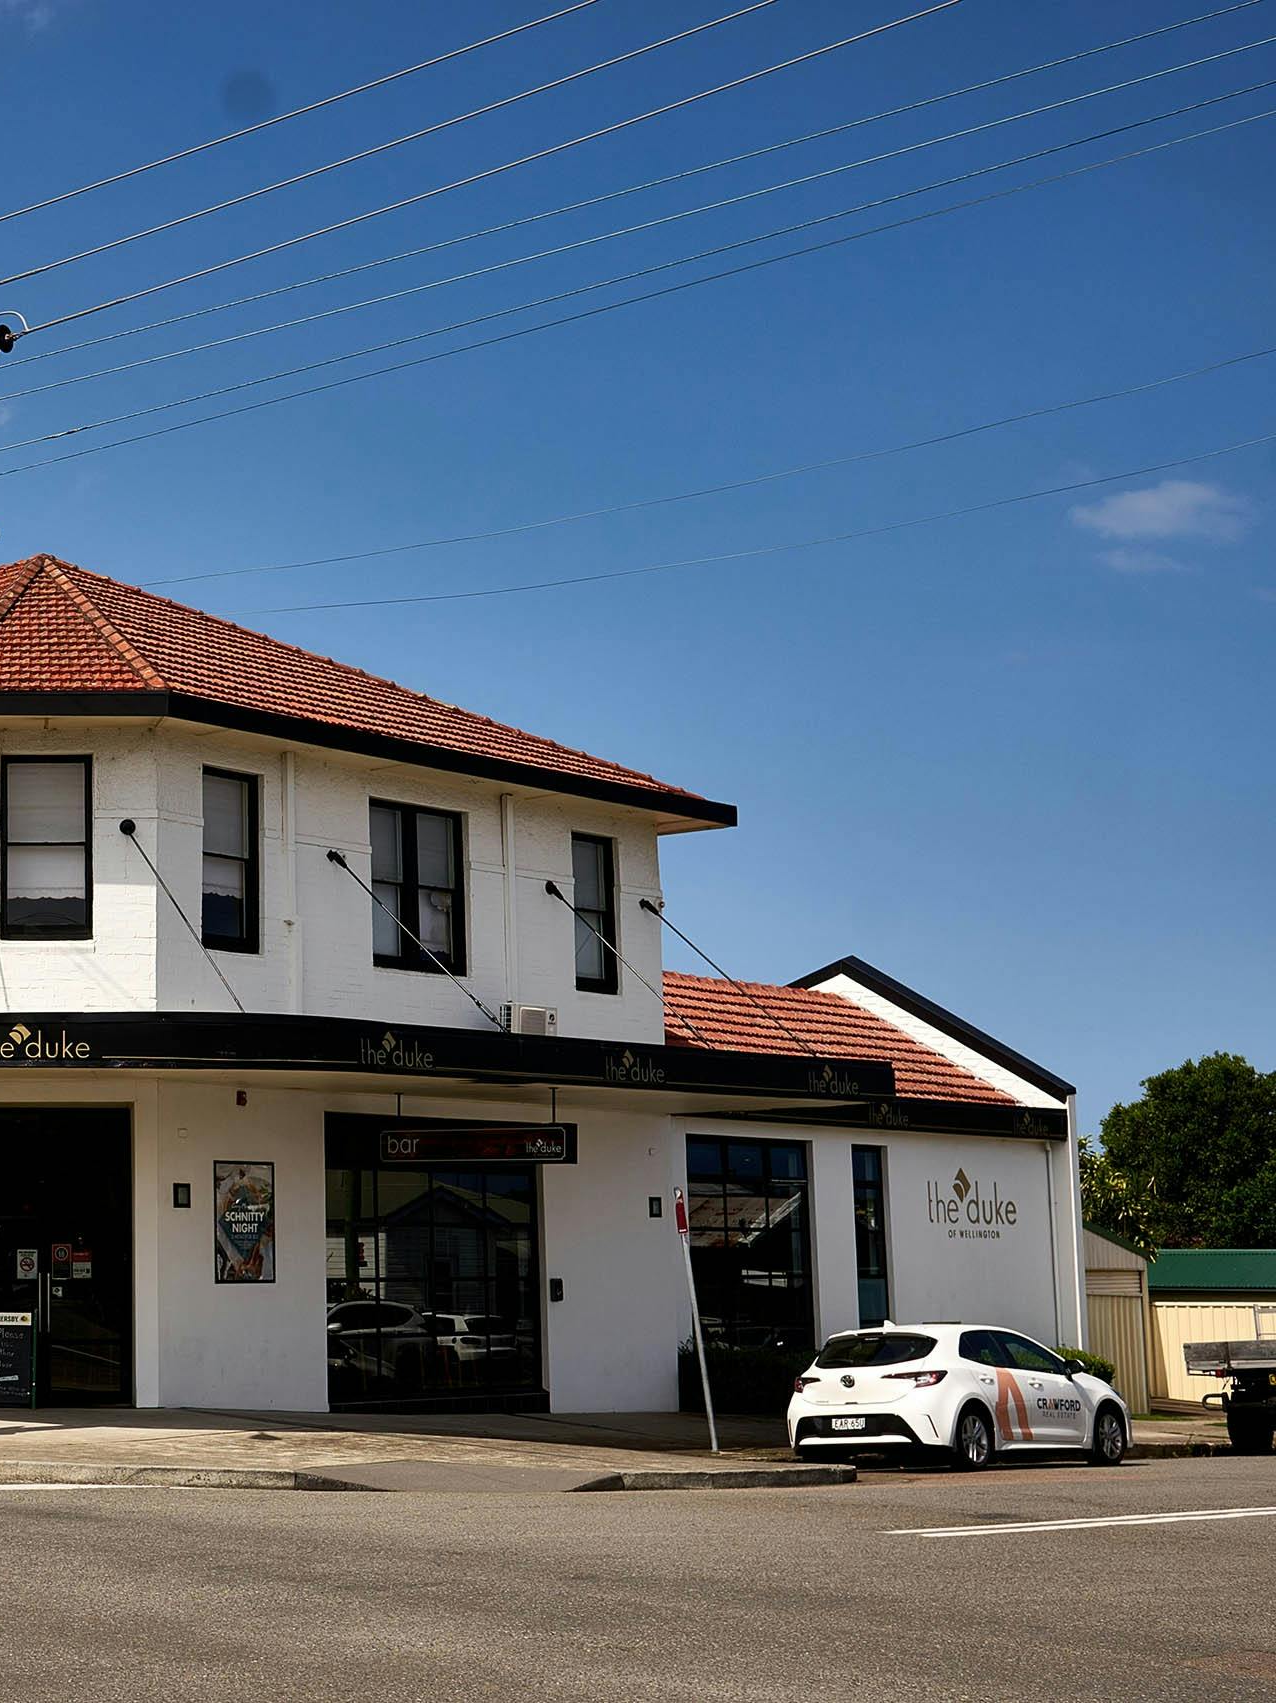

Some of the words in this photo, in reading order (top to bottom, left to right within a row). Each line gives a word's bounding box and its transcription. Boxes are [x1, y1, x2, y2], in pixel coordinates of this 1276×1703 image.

[25, 1030, 90, 1058] duke
[360, 1038, 387, 1065] the
[392, 1040, 434, 1068] duke
[605, 1056, 626, 1080] the
[631, 1057, 665, 1083] duke
[808, 1072, 827, 1093] the
[830, 1072, 860, 1096] duke
[868, 1103, 883, 1126] the
[885, 1106, 909, 1128] duke
[387, 1136, 420, 1154] bar
[526, 1141, 539, 1153] the
[540, 1141, 562, 1153] duke
[927, 1180, 959, 1224] the
[966, 1180, 1017, 1225] duke
[224, 1211, 265, 1222] SCHNITTY
[232, 1223, 259, 1233] NIGHT
[948, 1229, 957, 1239] OF
[959, 1229, 1000, 1239] WELLINGTON
[1036, 1398, 1081, 1412] CRAWFORD
